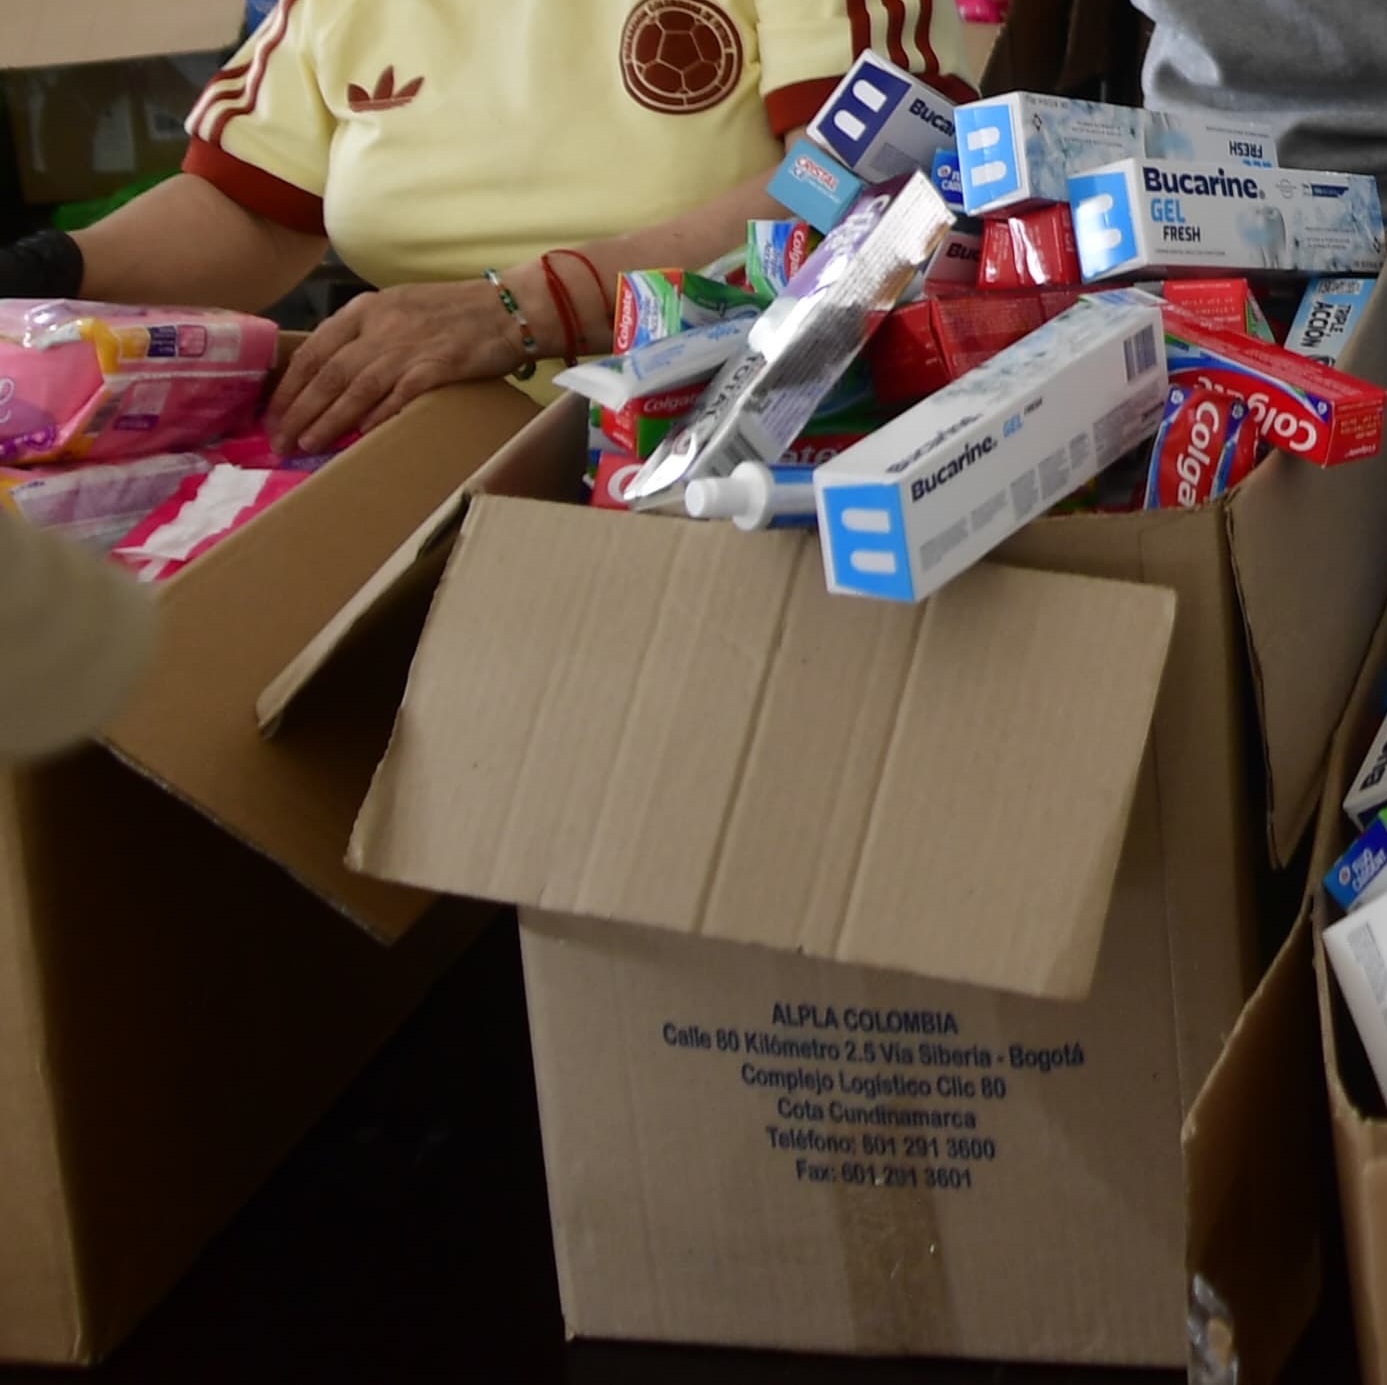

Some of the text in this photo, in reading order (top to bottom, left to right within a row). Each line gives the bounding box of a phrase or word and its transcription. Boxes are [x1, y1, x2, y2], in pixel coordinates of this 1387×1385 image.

[1229, 140, 1263, 159] FRESH
[1142, 166, 1259, 199] Bucarine
[1150, 198, 1187, 223] GEL
[1163, 225, 1201, 242] FRESH
[616, 289, 636, 351] Colgate
[1002, 414, 1024, 440] GEL
[911, 432, 995, 503] Bucarine
[1176, 401, 1220, 508] Colga
[772, 1002, 959, 1035] ALPLA COLOMBIA
[662, 1022, 711, 1049] Calle
[716, 1030, 740, 1051] 80
[744, 1032, 840, 1061] Kilómetro
[845, 1040, 876, 1063] 2.5
[1009, 1042, 1085, 1072] Bogotá
[741, 1063, 1007, 1100] Complejo Logístico Clic 80
[777, 1097, 977, 1130] Cota Cundinamarca
[903, 1137, 939, 1159] 291
[946, 1139, 996, 1160] 3600
[795, 1160, 837, 1183] Fax:
[840, 1165, 877, 1186] 601
[925, 1167, 972, 1190] 3601
